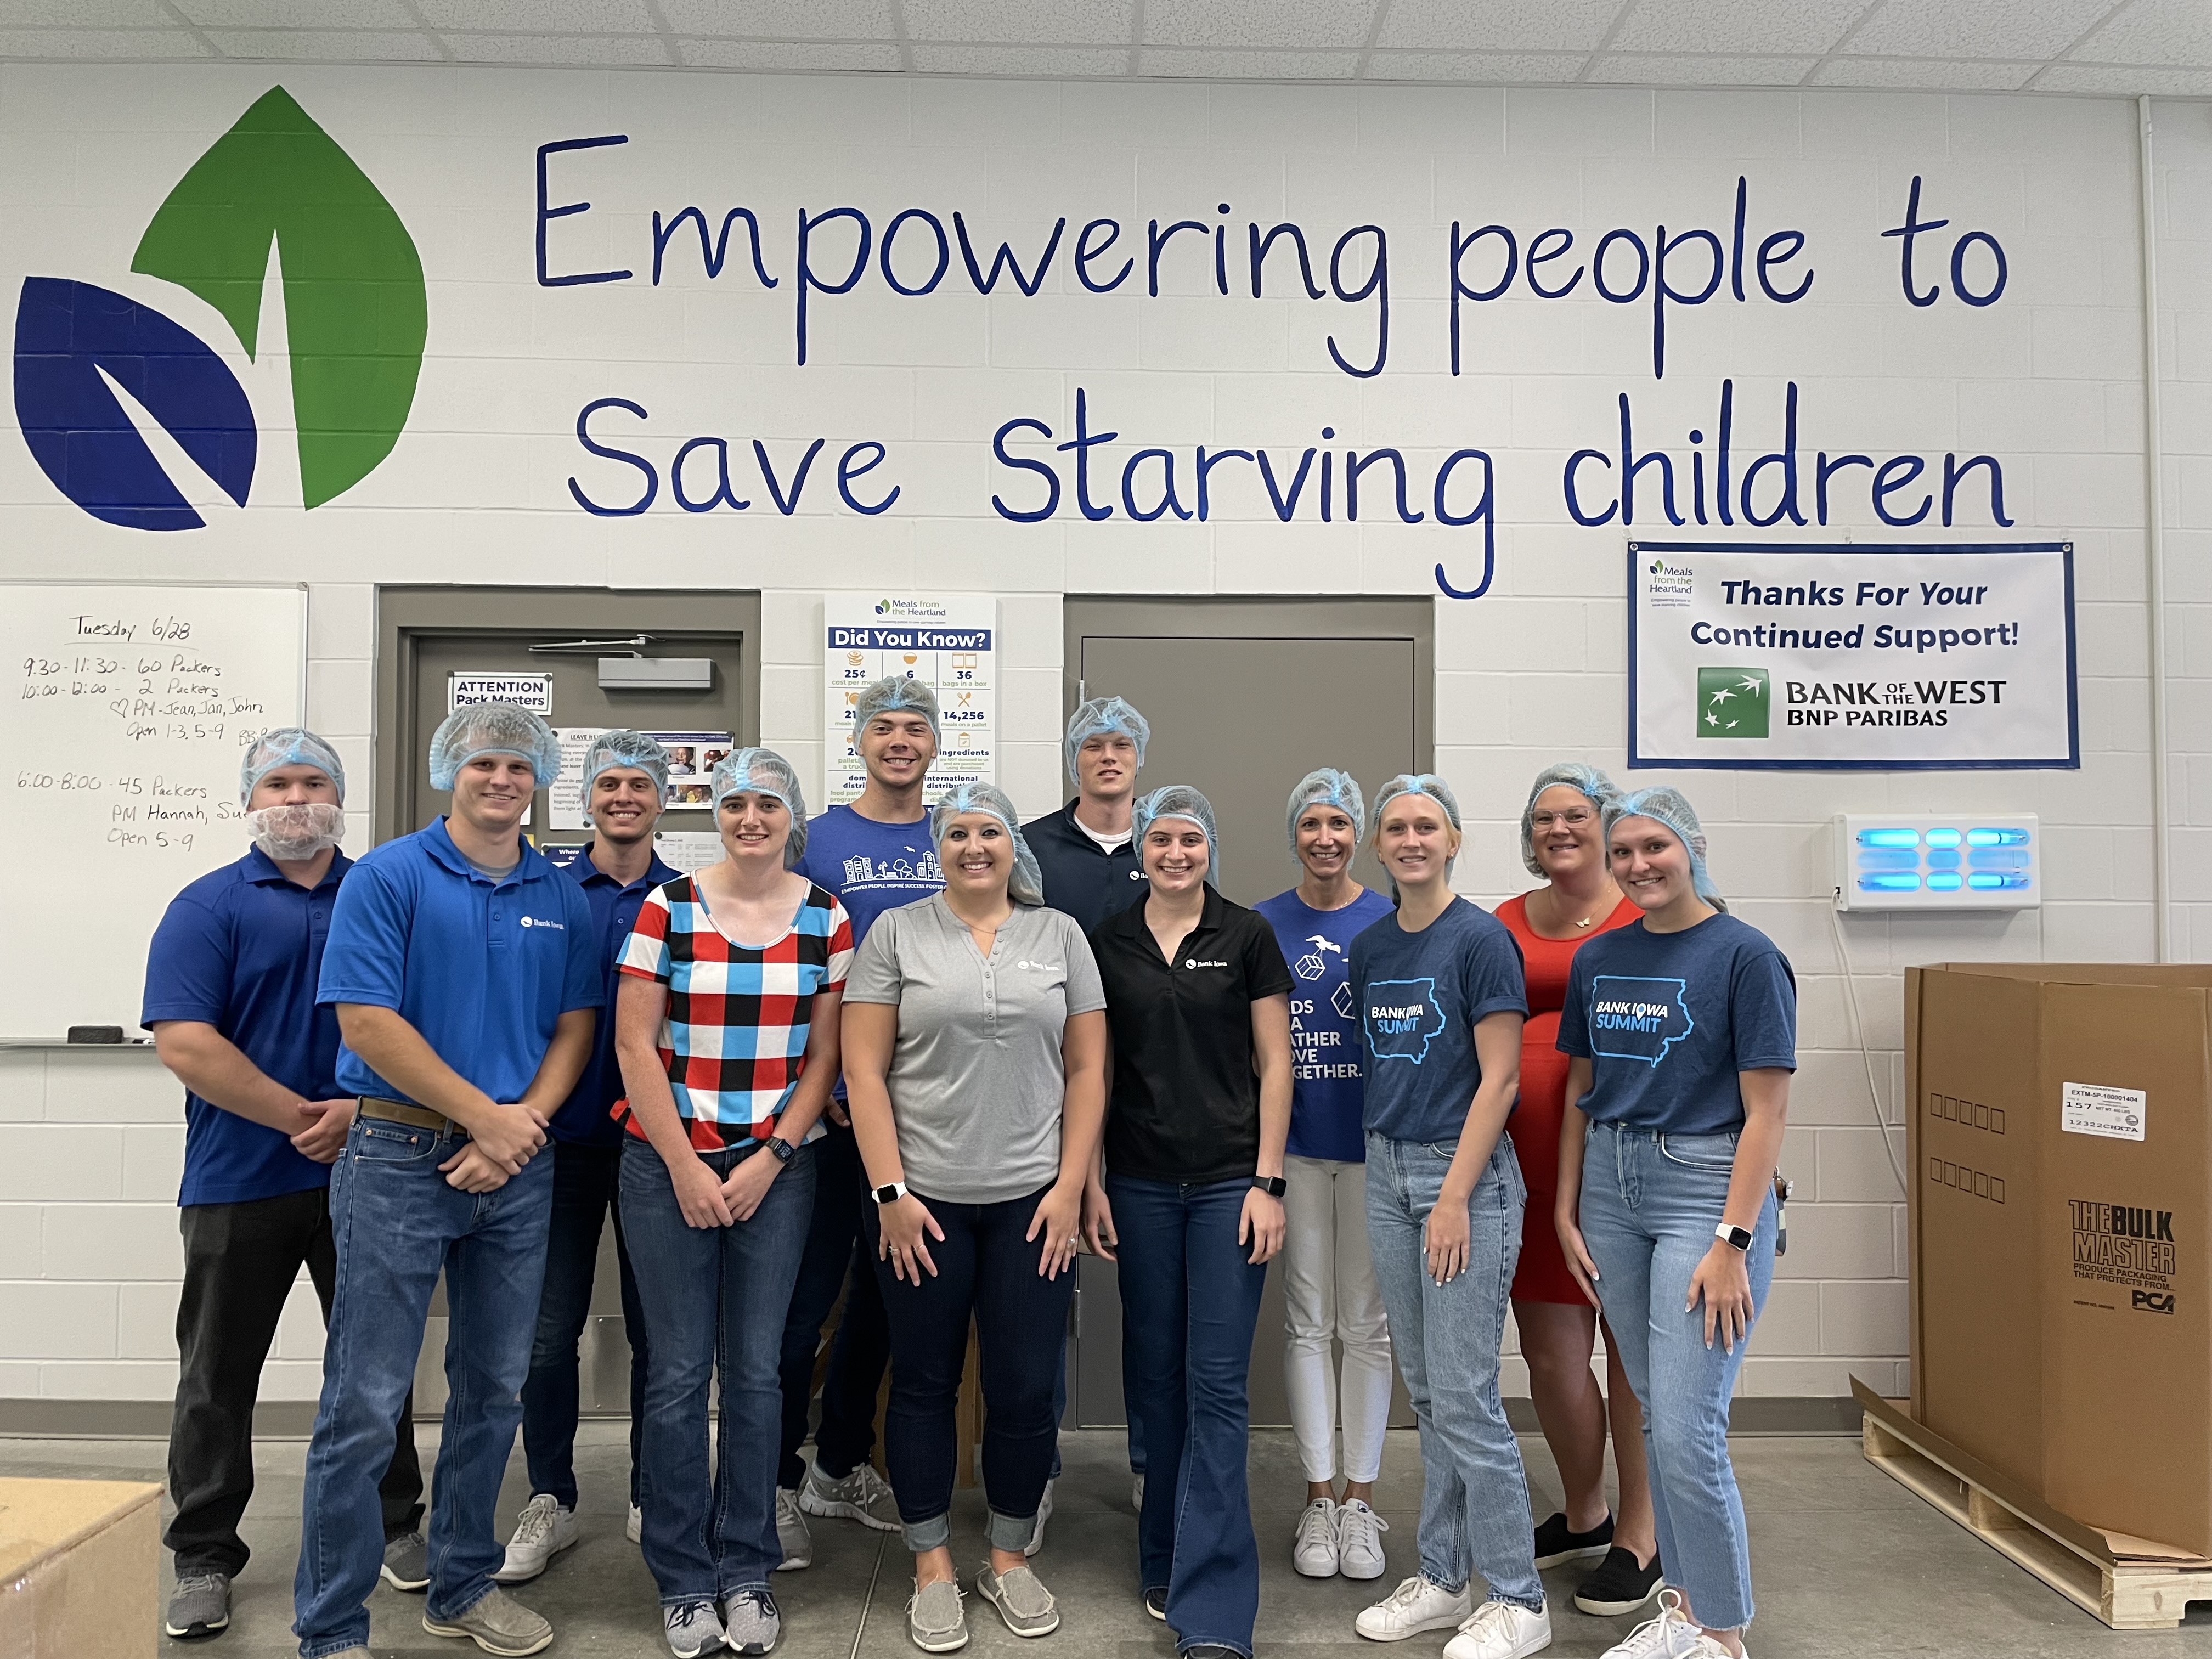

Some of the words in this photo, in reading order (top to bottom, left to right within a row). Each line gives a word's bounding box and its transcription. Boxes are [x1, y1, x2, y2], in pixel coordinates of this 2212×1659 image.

[536, 135, 1389, 378] Empowering
[1450, 176, 1813, 379] people
[1882, 176, 2007, 307] to
[568, 398, 900, 517] Save
[1563, 379, 2014, 528] children
[1664, 567, 1692, 575] Meals
[1650, 585, 1692, 594] Heartland
[1721, 580, 1844, 606] Thanks
[1857, 582, 1909, 606] For
[1920, 582, 1988, 605] Your
[892, 600, 917, 608] Meals
[69, 615, 137, 641] Tuesday
[152, 615, 191, 641] 6/28
[835, 629, 868, 646] Did
[874, 631, 912, 646] You
[917, 631, 986, 647] Know?
[1691, 622, 1864, 648] Continued
[1873, 622, 2018, 653] Support!
[137, 658, 162, 674] 60
[171, 654, 221, 677] Packers
[844, 670, 866, 678] 25¢
[957, 671, 972, 679] 36
[139, 679, 154, 695] 2
[167, 678, 219, 697] Packers
[458, 681, 544, 693] ATTENTION
[1786, 681, 1878, 705] BANK
[1887, 684, 1907, 693] OF
[1914, 681, 2006, 704] WEST
[228, 696, 263, 715] John
[456, 695, 489, 705] Pack
[492, 695, 545, 706] Masters
[1882, 695, 1914, 704] THE
[844, 710, 856, 719] 21
[943, 712, 984, 721] 14,256
[1787, 710, 1839, 726] BNP
[1845, 710, 1948, 726] PARIBAS
[126, 721, 156, 741] Open
[847, 748, 859, 756] 2
[119, 777, 142, 794] 45
[153, 775, 207, 799] Packers
[112, 804, 136, 822] PM
[147, 804, 208, 825] Hannah,
[107, 828, 148, 847] Open
[842, 884, 868, 894] EMPOWER
[1289, 1000, 1314, 1015] DS
[1372, 1006, 1406, 1019] BANK
[1596, 1001, 1631, 1014] BANK
[1632, 1003, 1668, 1019] IOWA
[1596, 1014, 1661, 1033] SUMMIT
[1293, 1064, 1363, 1080] GETHER.
[2066, 1101, 2092, 1109] 157
[2069, 1200, 2110, 1234] THE
[2111, 1205, 2174, 1242] BULK
[2073, 1231, 2175, 1276] MASTER
[2073, 1262, 2114, 1274] PRODUCE
[2116, 1268, 2166, 1283] PACKAGING
[2073, 1270, 2095, 1279] THAT
[2097, 1273, 2142, 1286] PROTECTS
[2132, 1290, 2174, 1312] PCA
